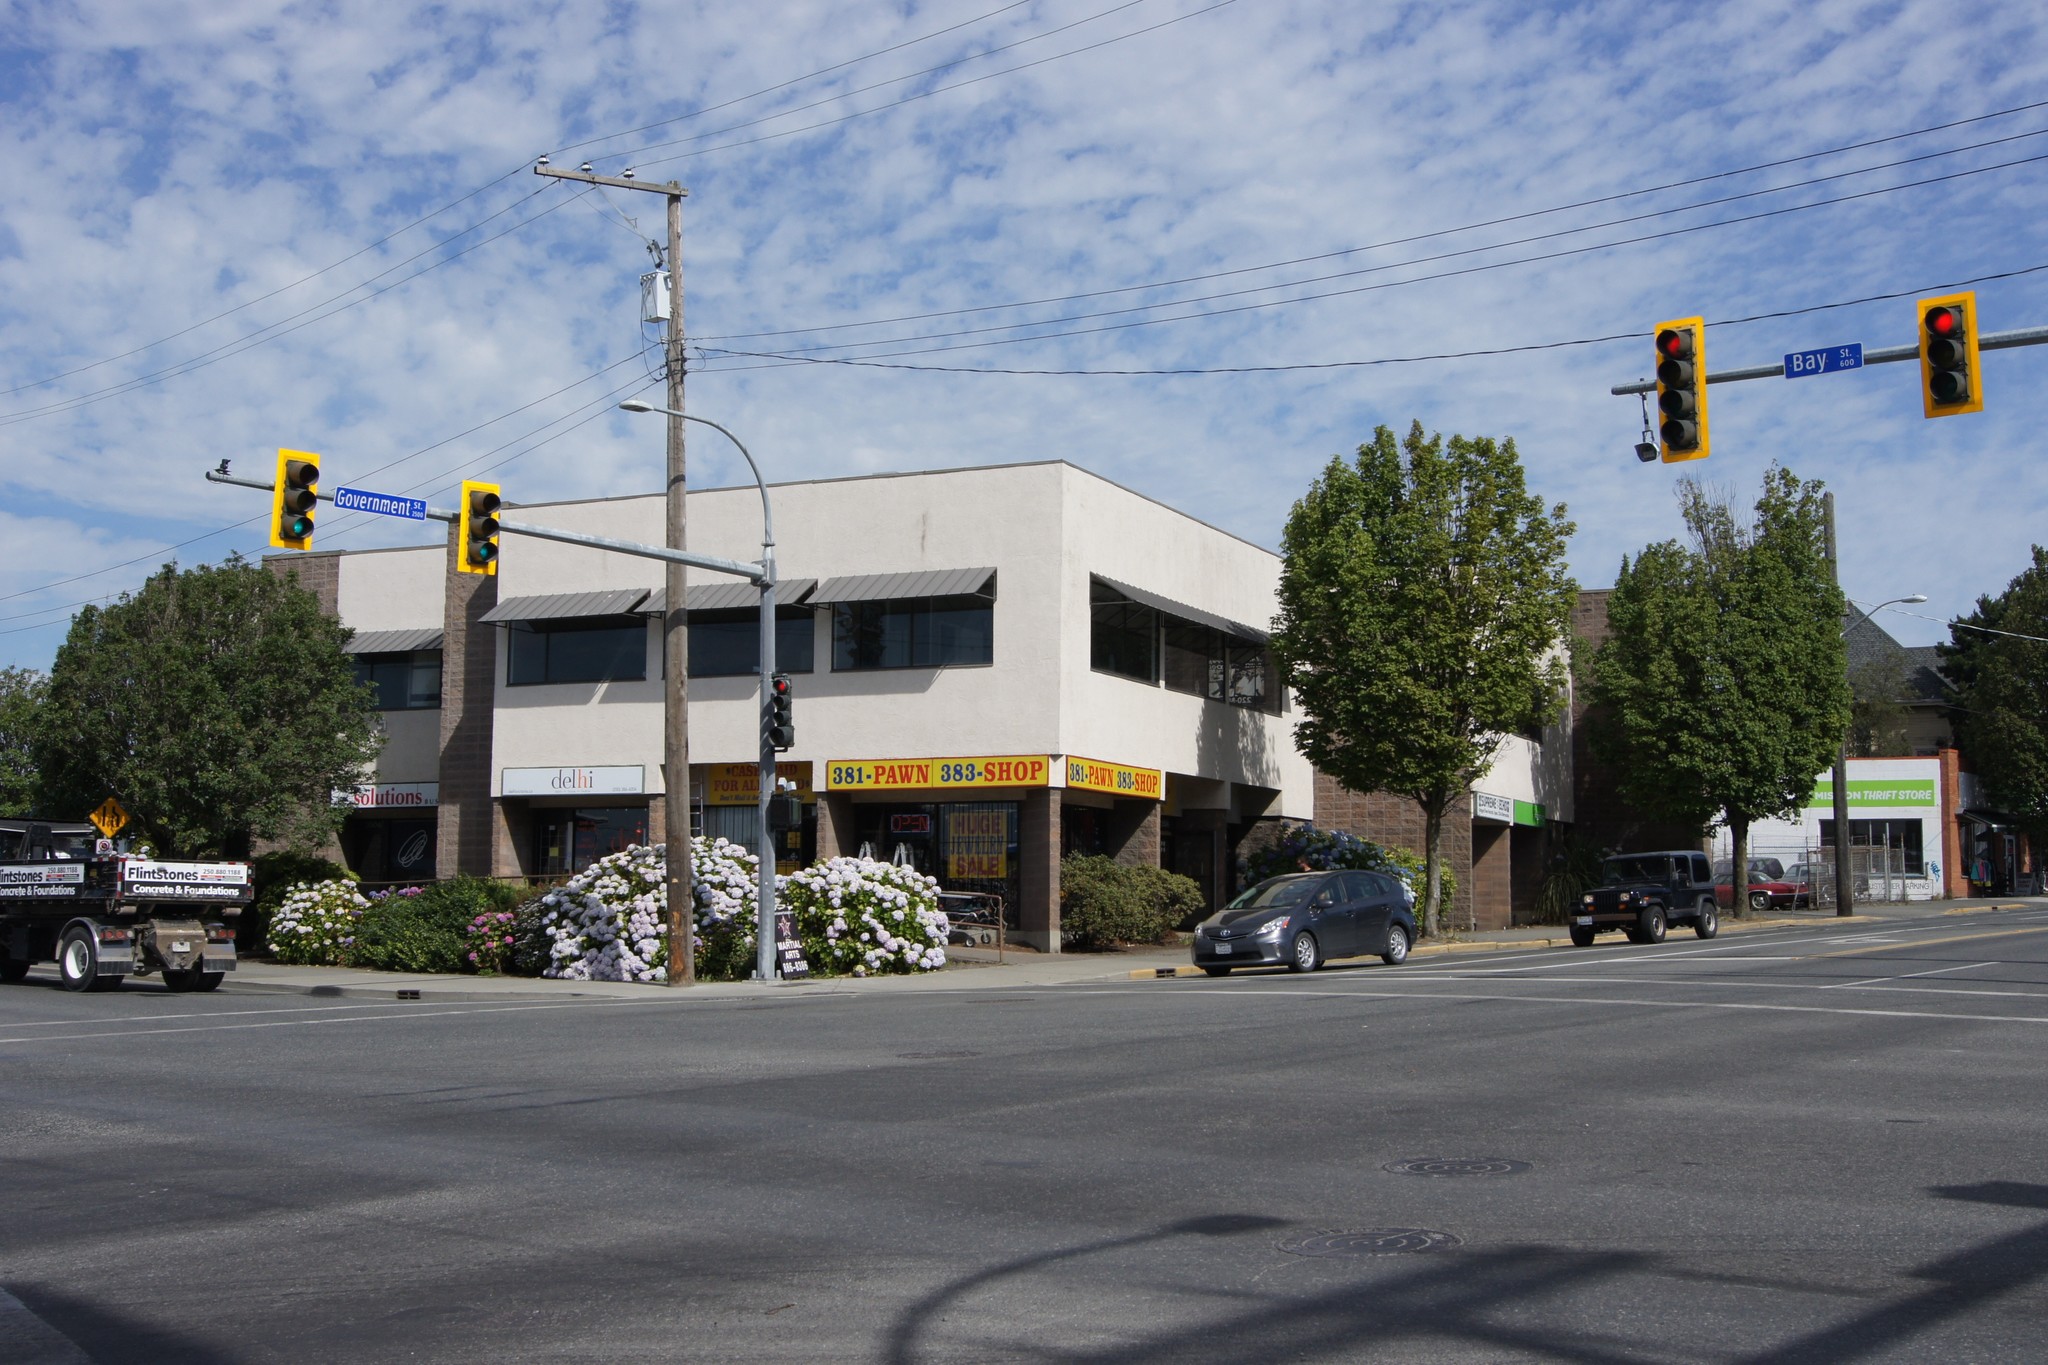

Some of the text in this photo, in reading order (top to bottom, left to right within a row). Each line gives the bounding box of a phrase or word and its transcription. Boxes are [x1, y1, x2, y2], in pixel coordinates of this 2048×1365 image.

[1792, 347, 1852, 373] Bay St.
[1839, 358, 1855, 368] 600
[337, 489, 423, 516] Government St.
[411, 510, 424, 518] 2500
[551, 768, 593, 789] delhi
[832, 764, 930, 785] 381-PAWN
[940, 760, 1043, 782] 383-SHOP
[1069, 763, 1158, 794] 381-PAWN 383-SHOP
[714, 780, 739, 792] FOR
[353, 787, 422, 806] solutions
[1815, 790, 1932, 800] MISON THRIFT STORE
[892, 815, 929, 831] OPEN
[954, 814, 1001, 834] HUGE
[128, 866, 199, 881] Flintstones
[955, 856, 1001, 876] SALE
[27, 886, 32, 896] &
[33, 884, 76, 896] Foundations
[132, 884, 240, 896] Concrete & Foundations
[1905, 882, 1930, 890] ARKING
[777, 940, 803, 951] MARTIAL
[785, 950, 801, 960] ARTS
